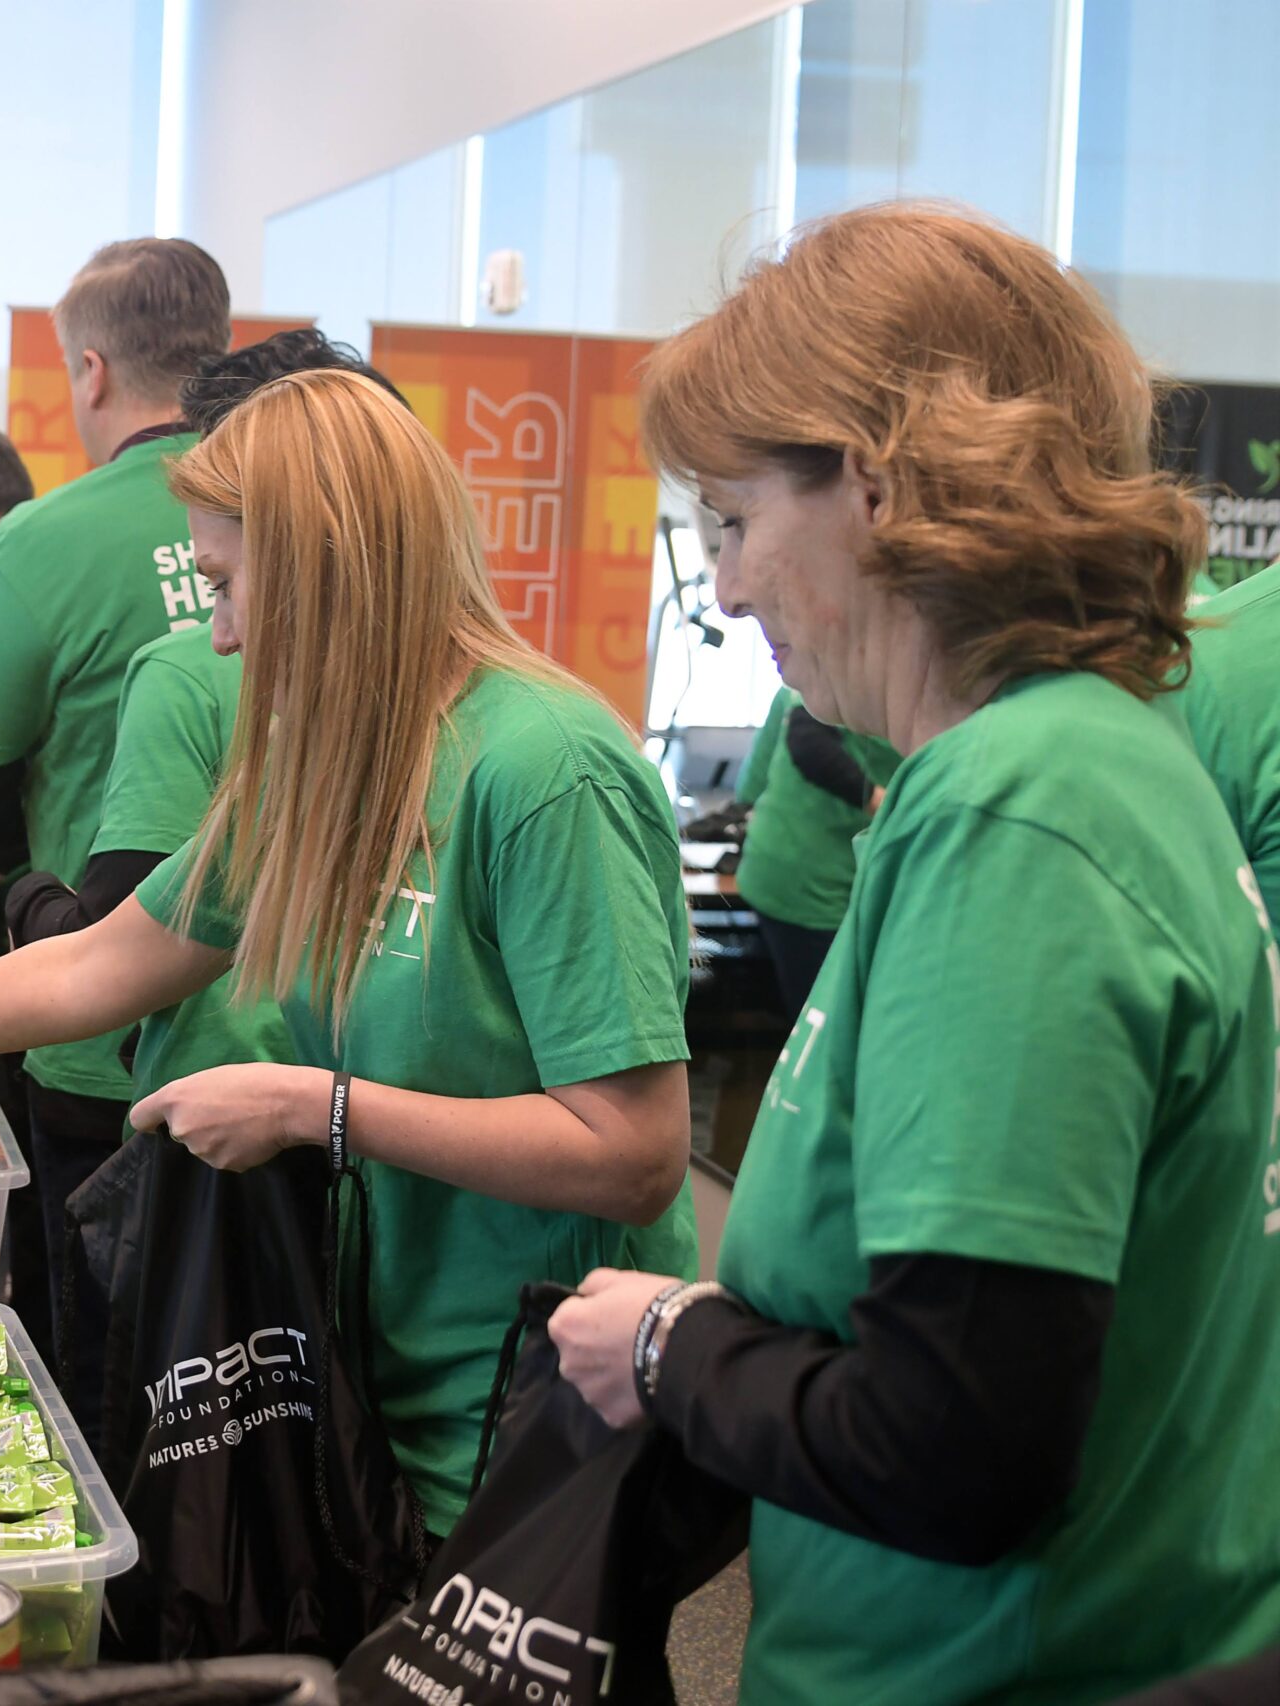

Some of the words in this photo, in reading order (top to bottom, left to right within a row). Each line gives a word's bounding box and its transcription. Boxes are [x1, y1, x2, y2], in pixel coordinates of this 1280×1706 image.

[333, 1084, 346, 1124] POWER
[158, 1370, 299, 1429] FOUNDATION
[149, 1434, 220, 1469] NATURES
[243, 1401, 314, 1431] SUNSHINE
